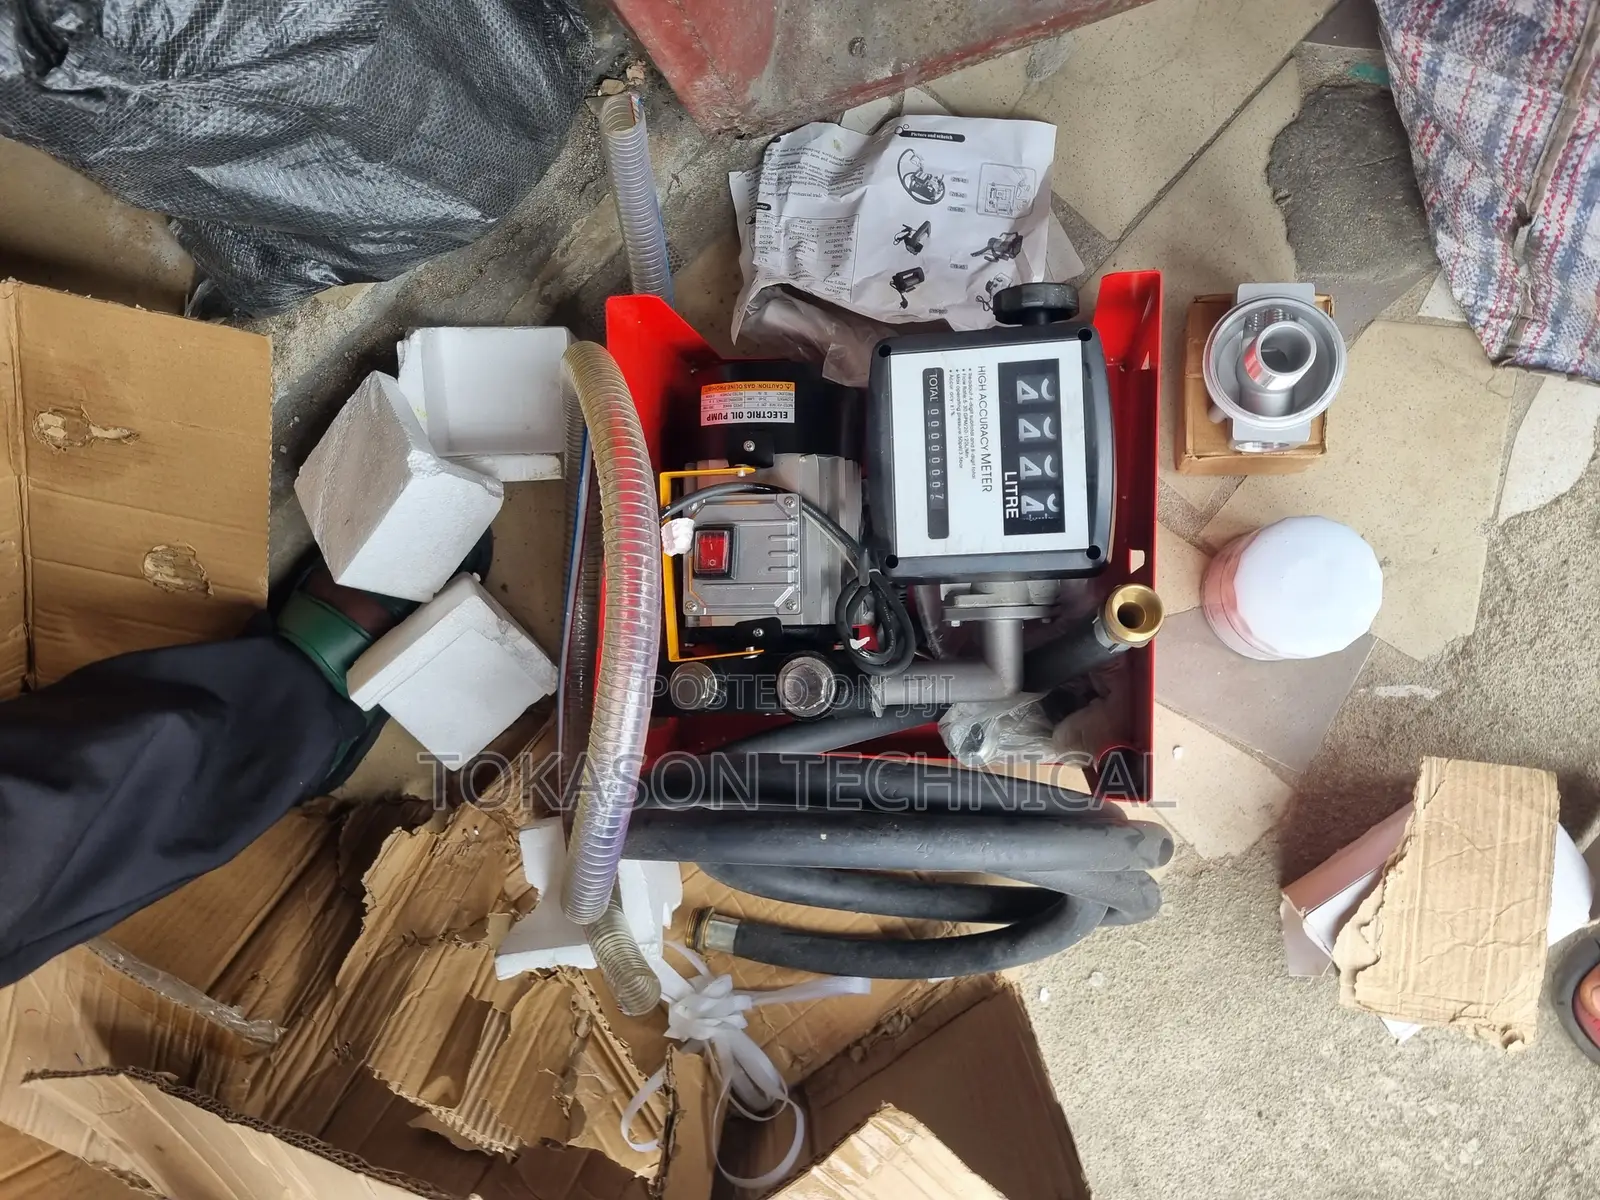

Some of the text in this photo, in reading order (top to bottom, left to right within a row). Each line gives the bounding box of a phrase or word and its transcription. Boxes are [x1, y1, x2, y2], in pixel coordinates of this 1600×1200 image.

[929, 373, 938, 401] TOTAL
[707, 412, 728, 421] PUMP
[747, 411, 788, 419] ELECTRIC
[978, 366, 992, 492] HIGH ACCURACY METER
[1004, 471, 1019, 519] LITRE
